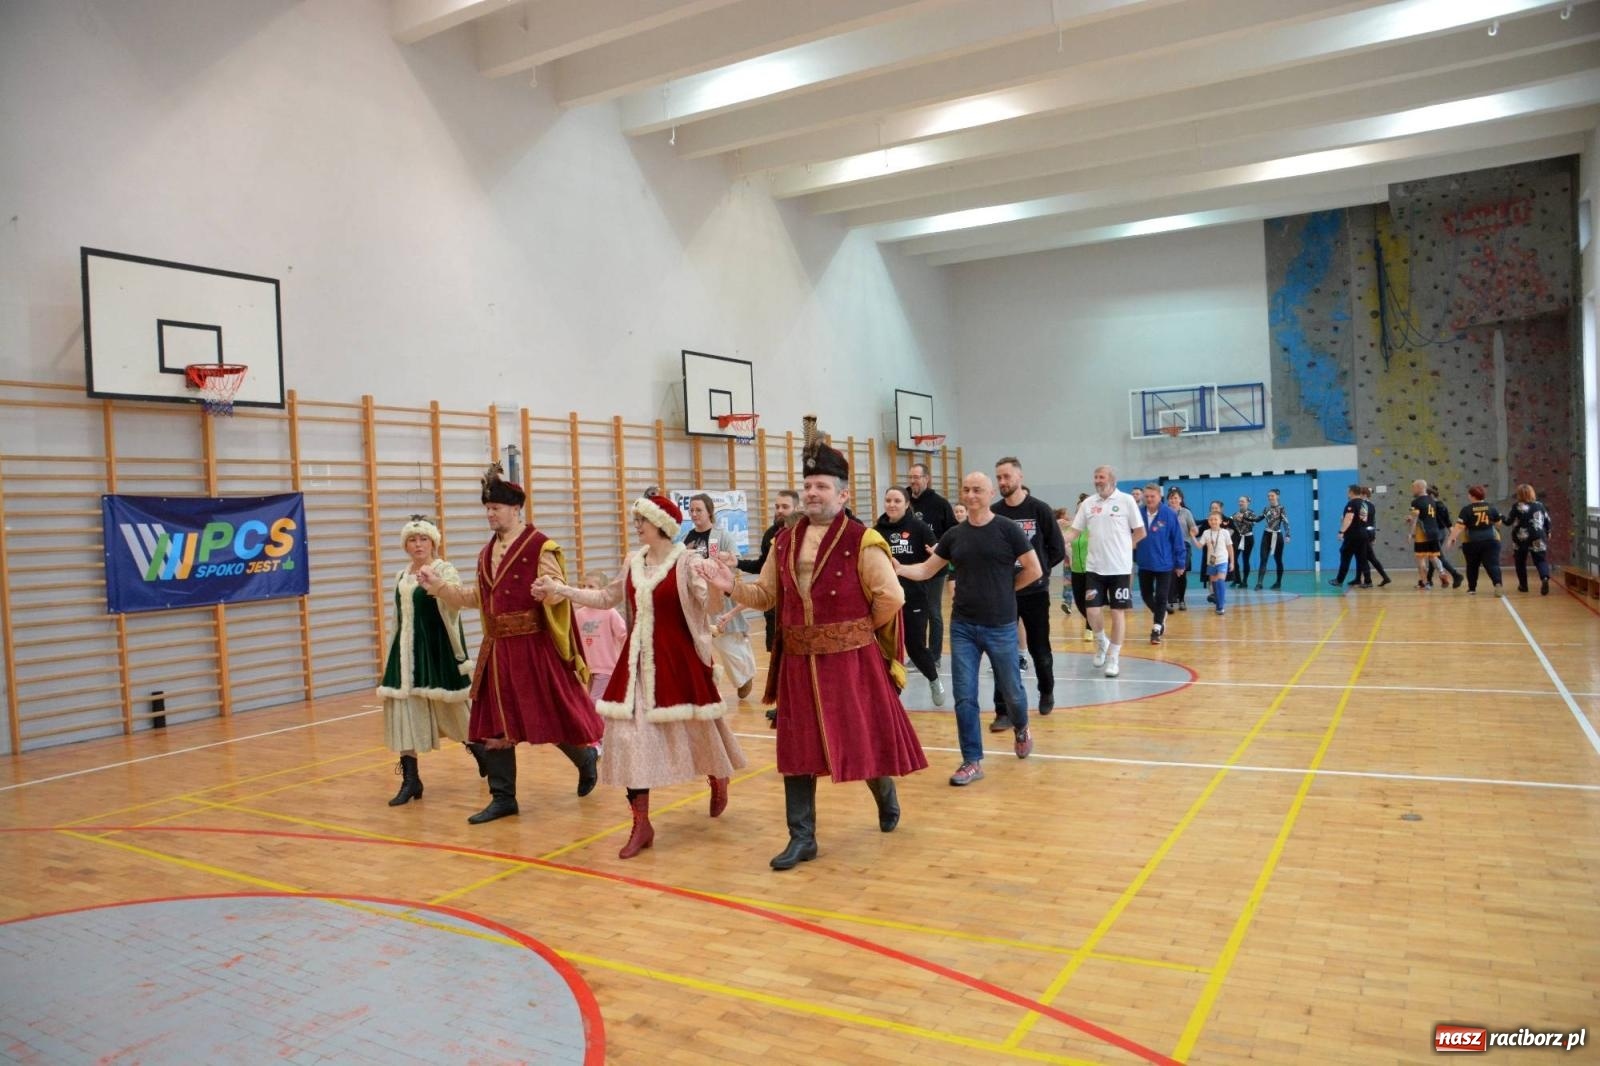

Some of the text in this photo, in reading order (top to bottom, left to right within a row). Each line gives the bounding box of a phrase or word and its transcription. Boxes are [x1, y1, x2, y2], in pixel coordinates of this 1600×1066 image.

[1428, 504, 1435, 518] 4
[1473, 512, 1489, 527] 74
[890, 545, 914, 554] ETBALL
[195, 559, 281, 578] SPOKO JEST
[1115, 587, 1129, 600] 60
